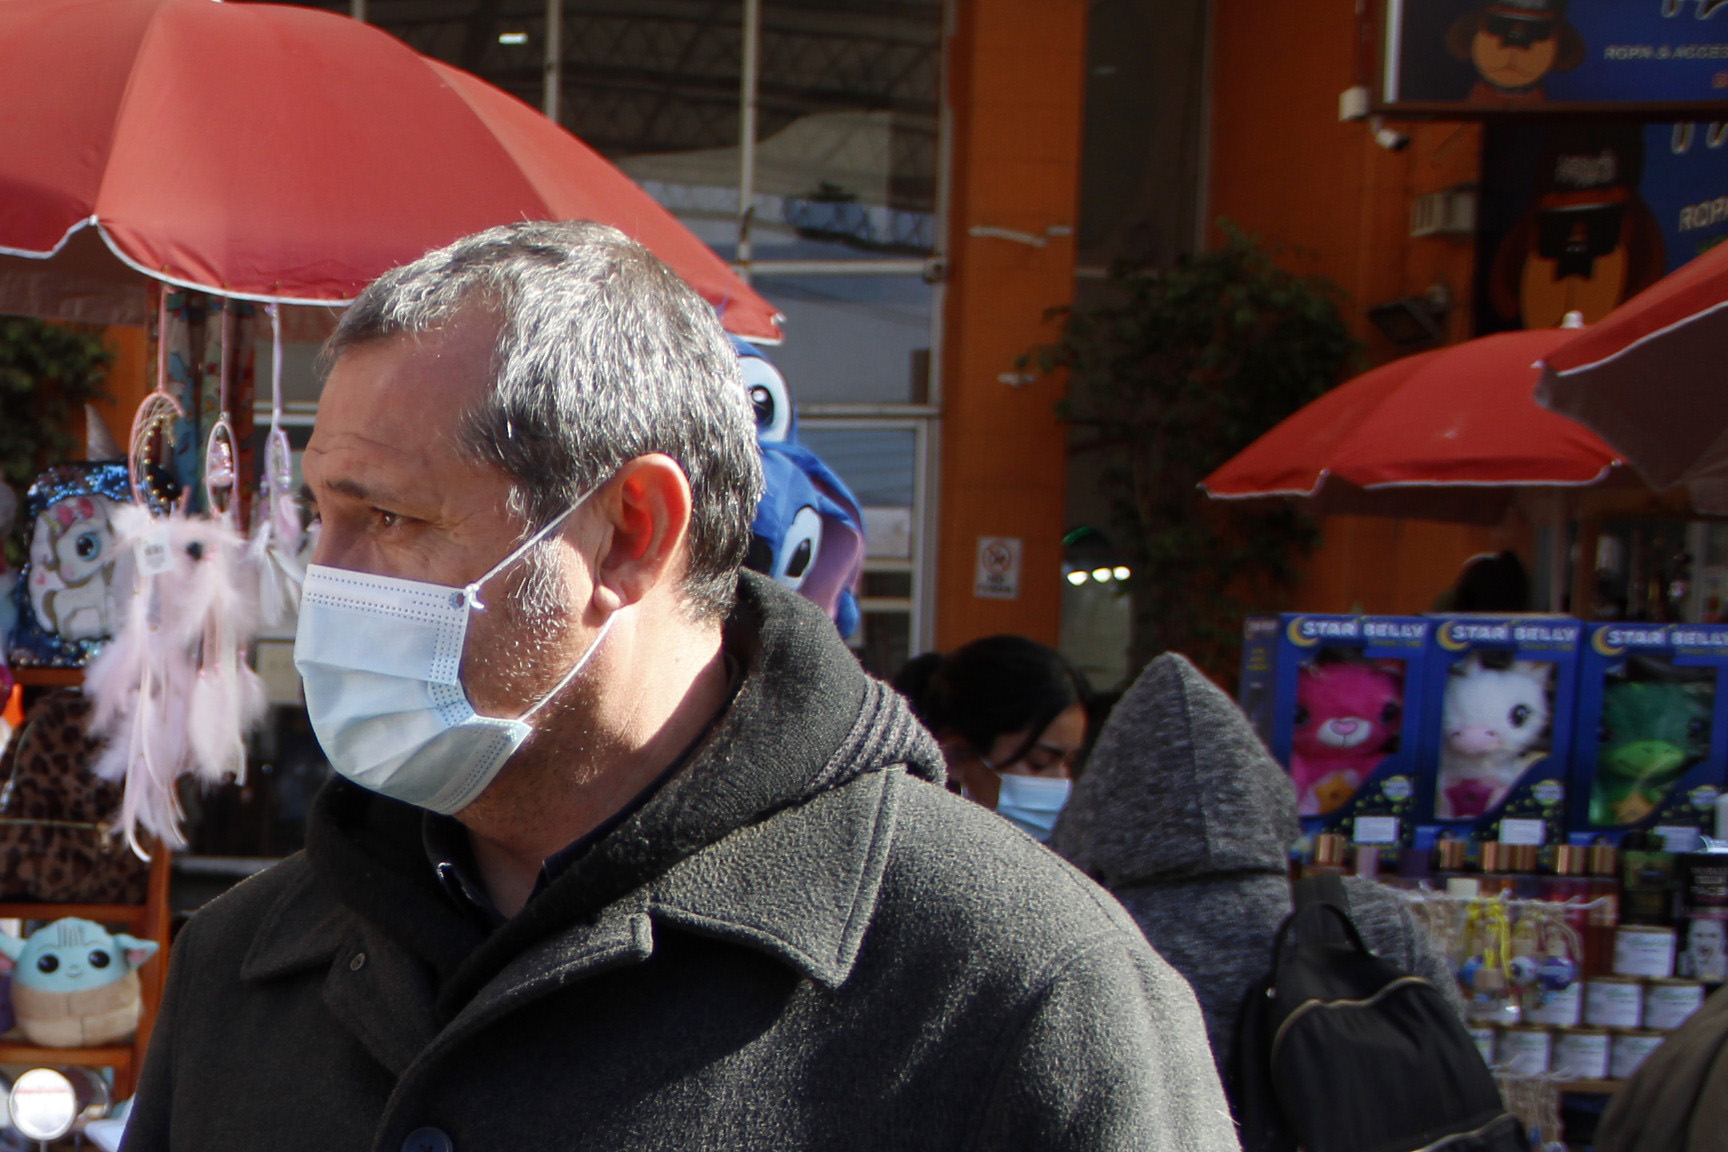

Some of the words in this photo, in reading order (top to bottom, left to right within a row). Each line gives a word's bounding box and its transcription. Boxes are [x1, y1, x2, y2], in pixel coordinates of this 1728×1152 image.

[1678, 196, 1728, 233] ROP
[1301, 621, 1358, 639] STAR
[1363, 621, 1427, 640] BELLY
[1452, 624, 1508, 642] STAR
[1514, 626, 1580, 645] BELLY
[1607, 628, 1662, 646] STAR
